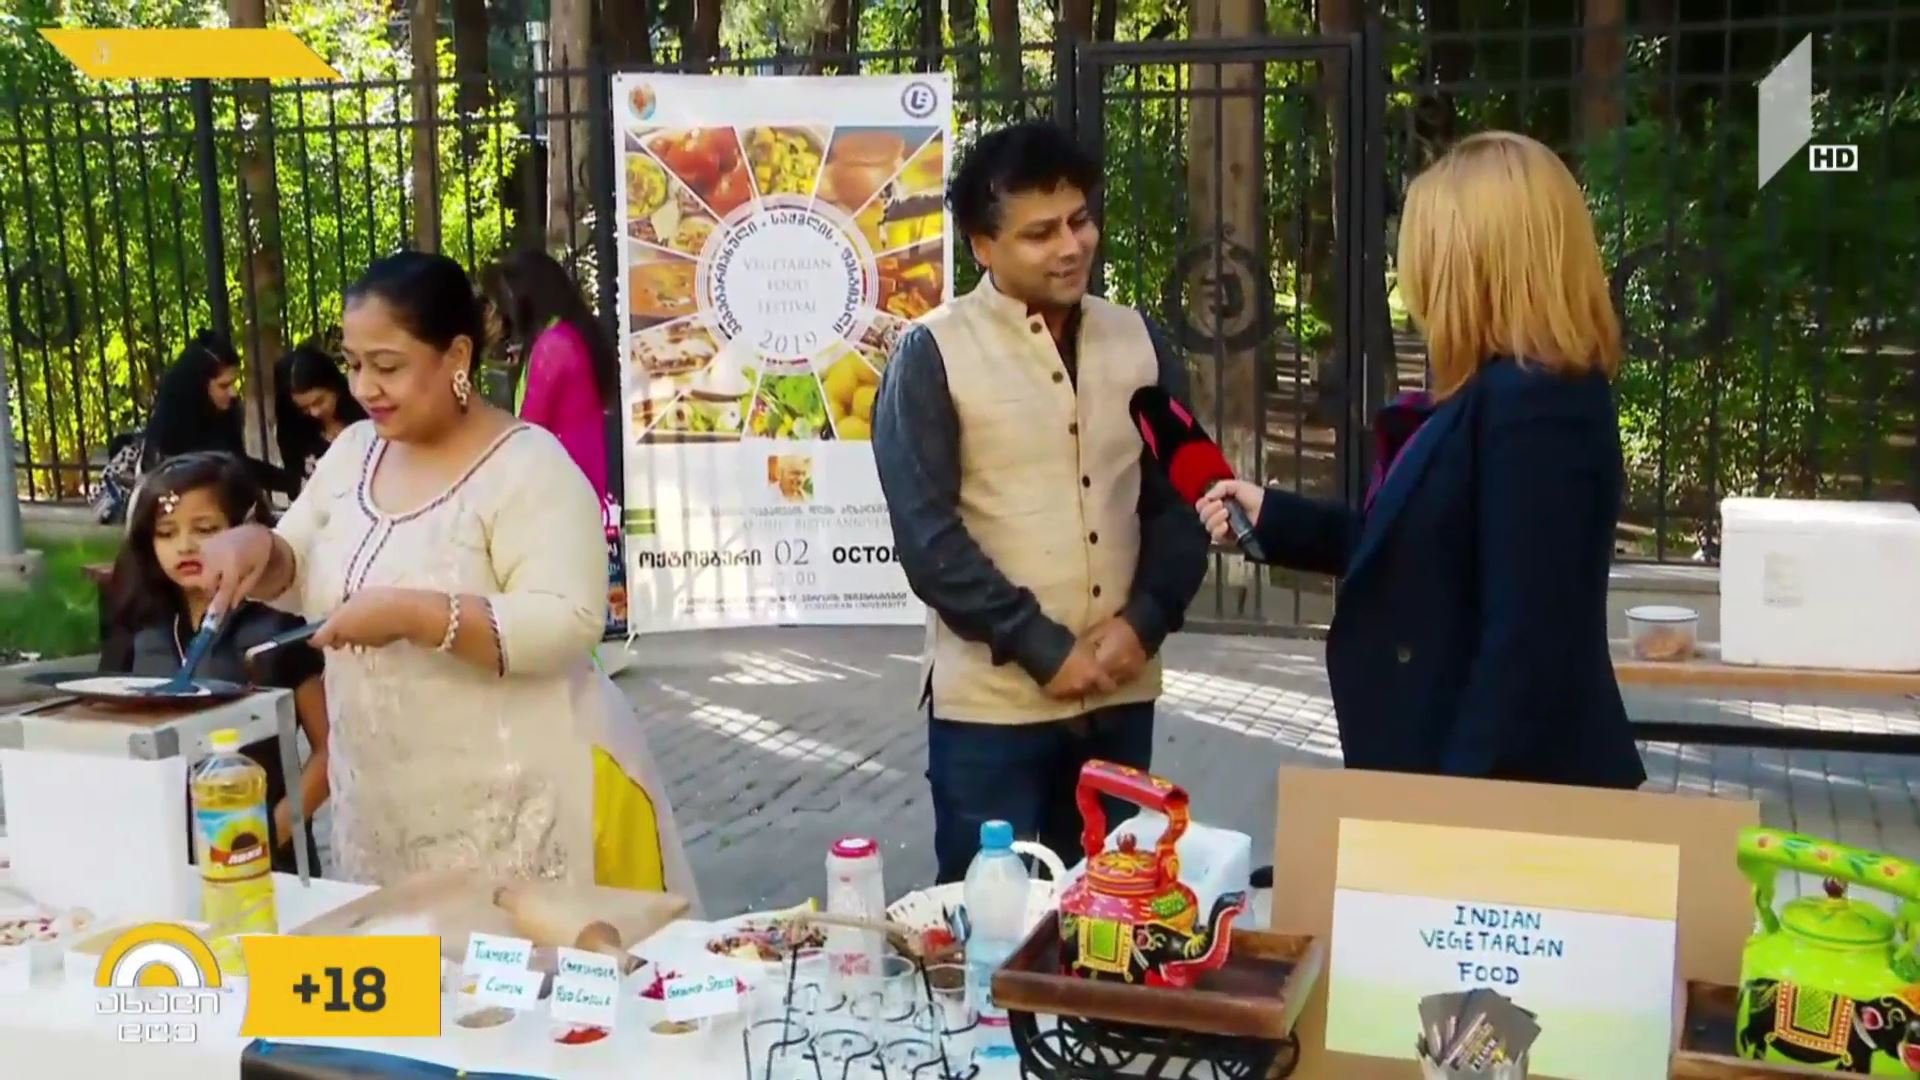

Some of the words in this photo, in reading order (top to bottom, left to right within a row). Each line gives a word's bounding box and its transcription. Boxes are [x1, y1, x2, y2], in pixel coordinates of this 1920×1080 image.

[743, 257, 832, 271] VEGETARIAN
[767, 278, 809, 292] FOOD
[758, 329, 818, 355] 2019
[639, 549, 762, 568] ოქტომბერი
[774, 539, 810, 566] 02
[1454, 904, 1541, 930] INDIAN
[1418, 928, 1564, 957] VEGETARIAN
[1457, 961, 1520, 985] FOOD
